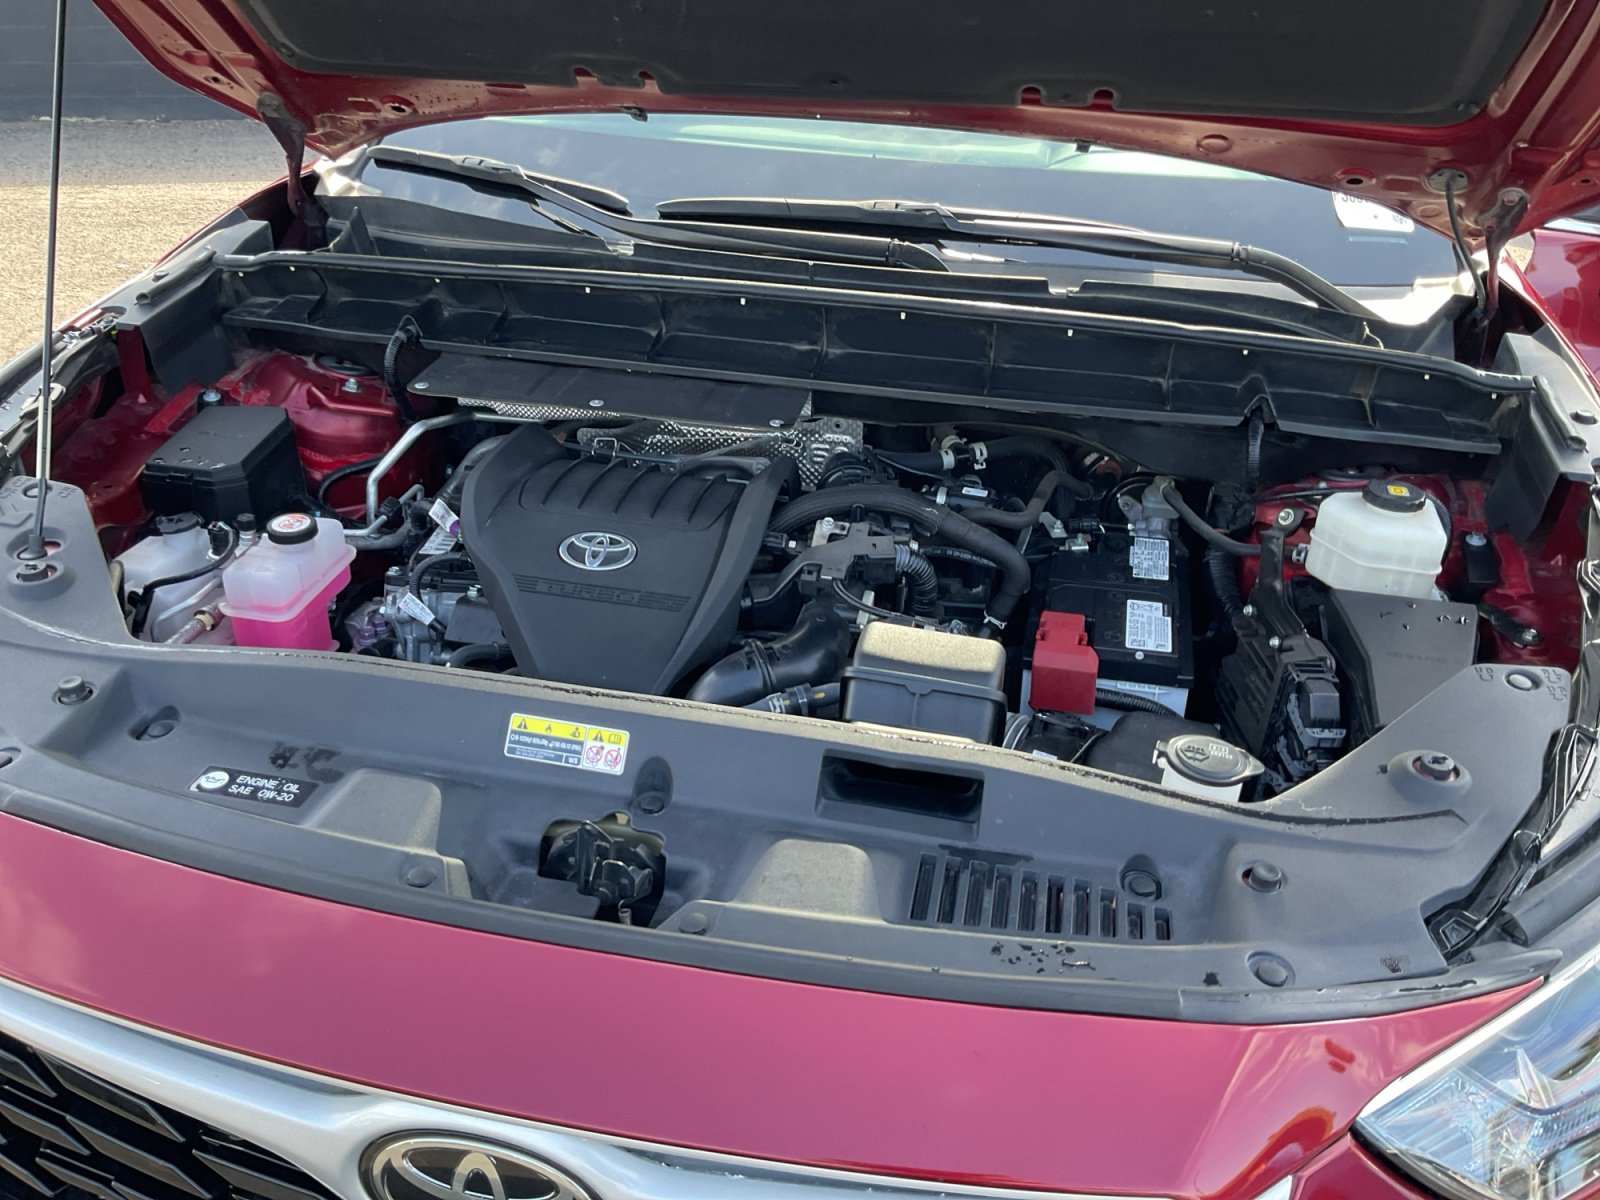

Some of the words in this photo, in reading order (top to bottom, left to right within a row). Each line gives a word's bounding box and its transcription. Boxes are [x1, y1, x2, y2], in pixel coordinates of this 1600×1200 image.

[541, 580, 641, 605] TURBO
[228, 784, 254, 796] SAE
[258, 790, 294, 802] 0W-20
[236, 775, 280, 789] ENGINE
[283, 783, 300, 793] OIL
